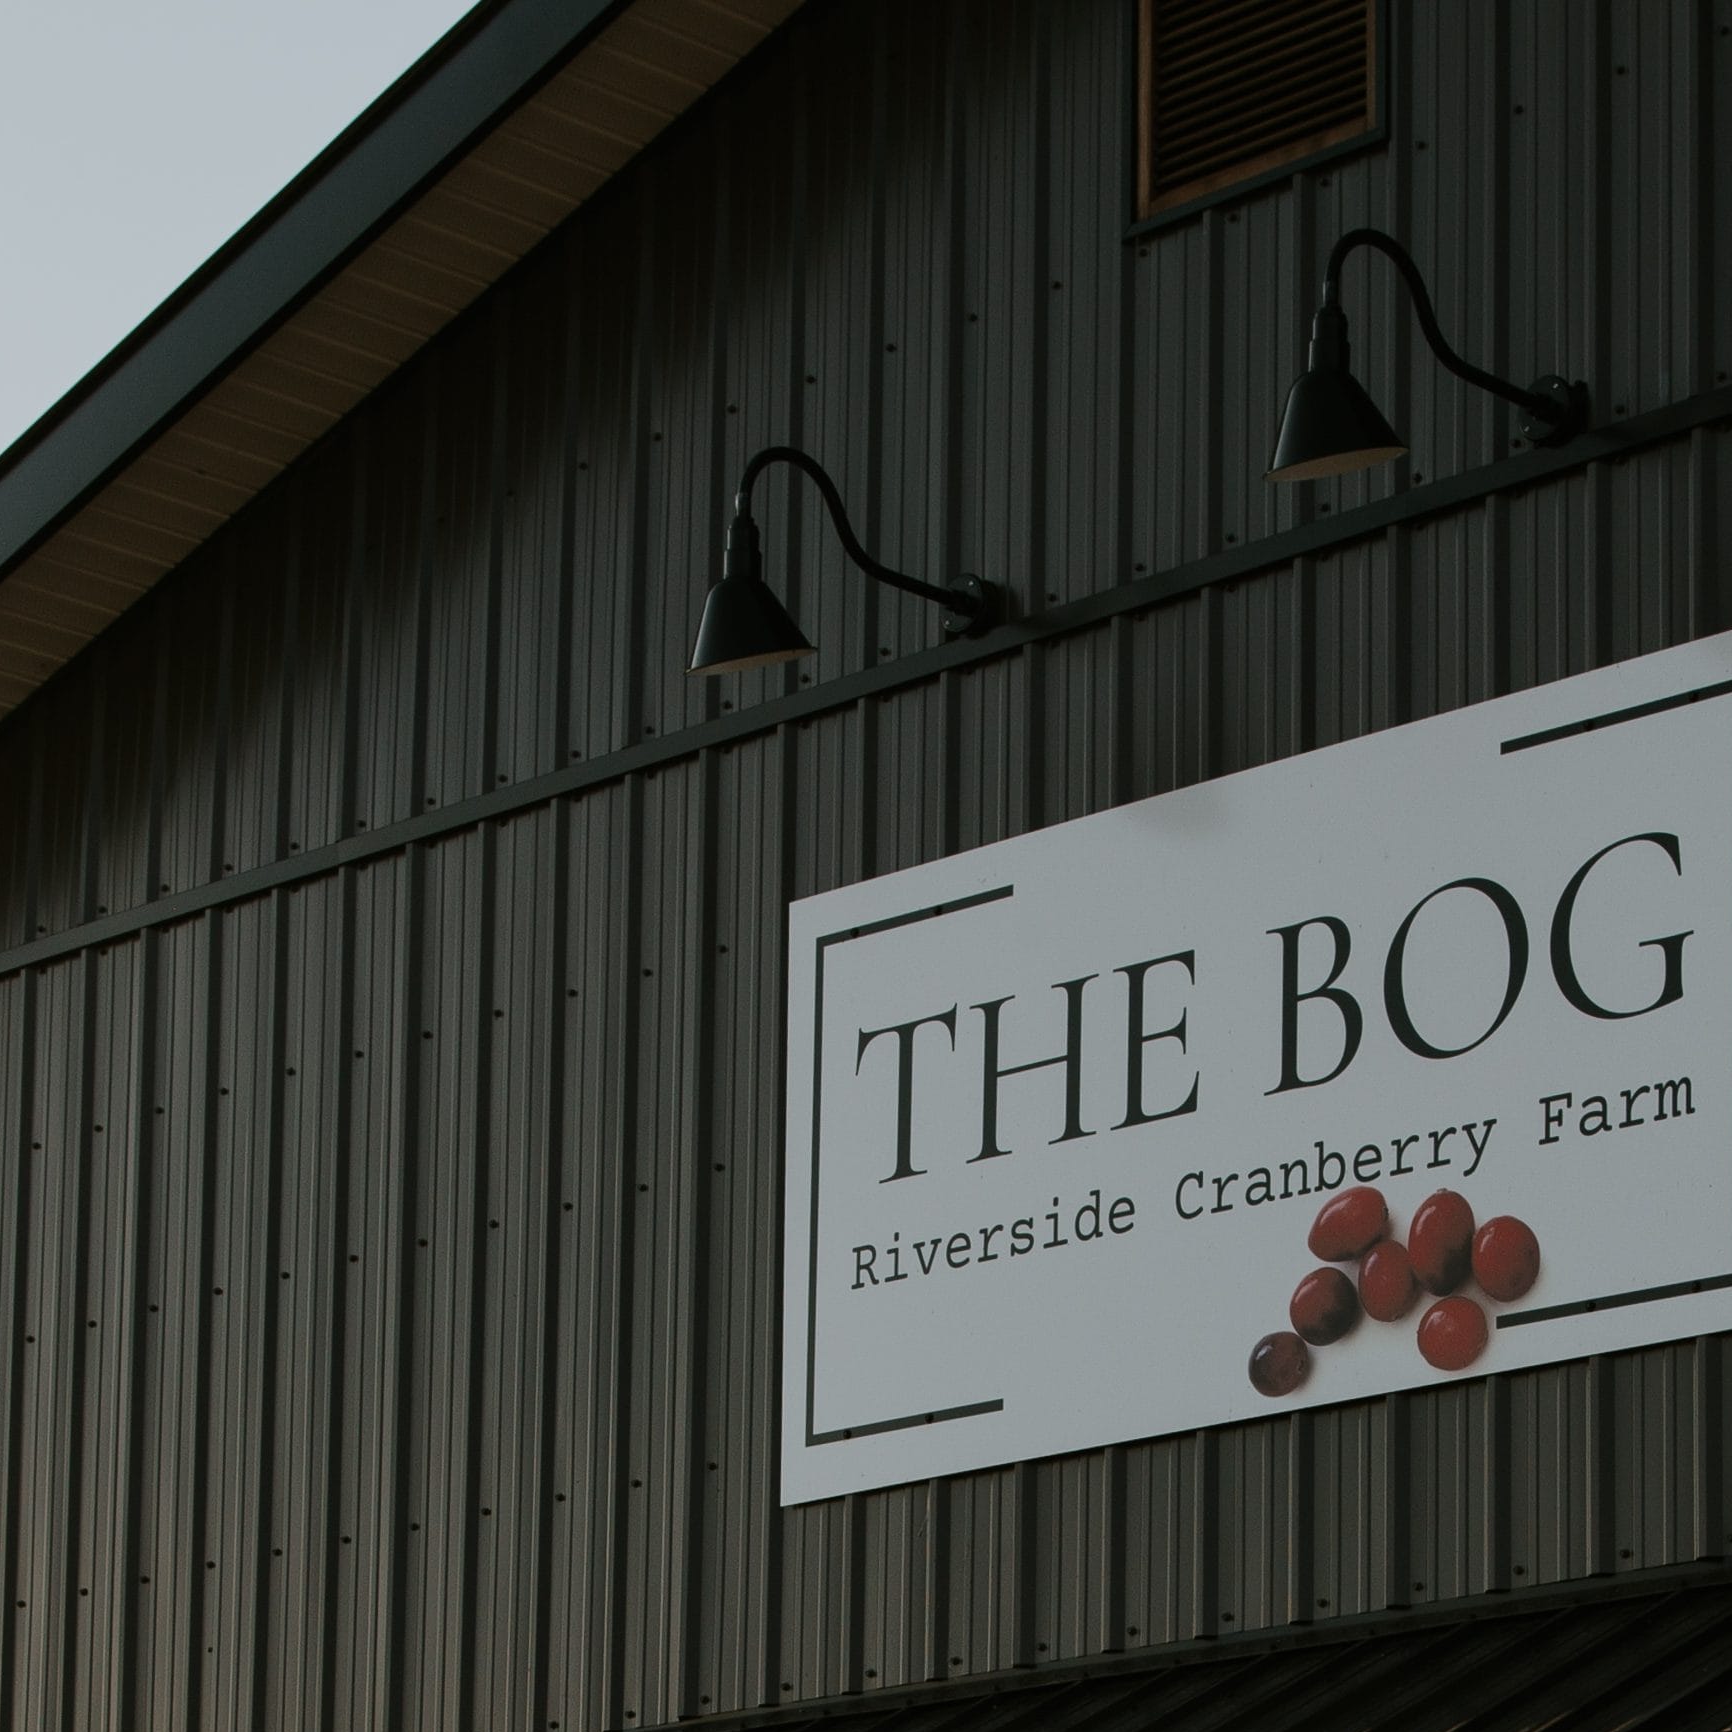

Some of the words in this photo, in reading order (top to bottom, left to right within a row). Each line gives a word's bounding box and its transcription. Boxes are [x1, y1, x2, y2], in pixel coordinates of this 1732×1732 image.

[854, 948, 1201, 1185] THE
[1263, 830, 1696, 1098] BOG
[850, 1188, 1137, 1291] Riverside
[1174, 1117, 1499, 1221] Cranberry
[1537, 1074, 1697, 1147] Farm
